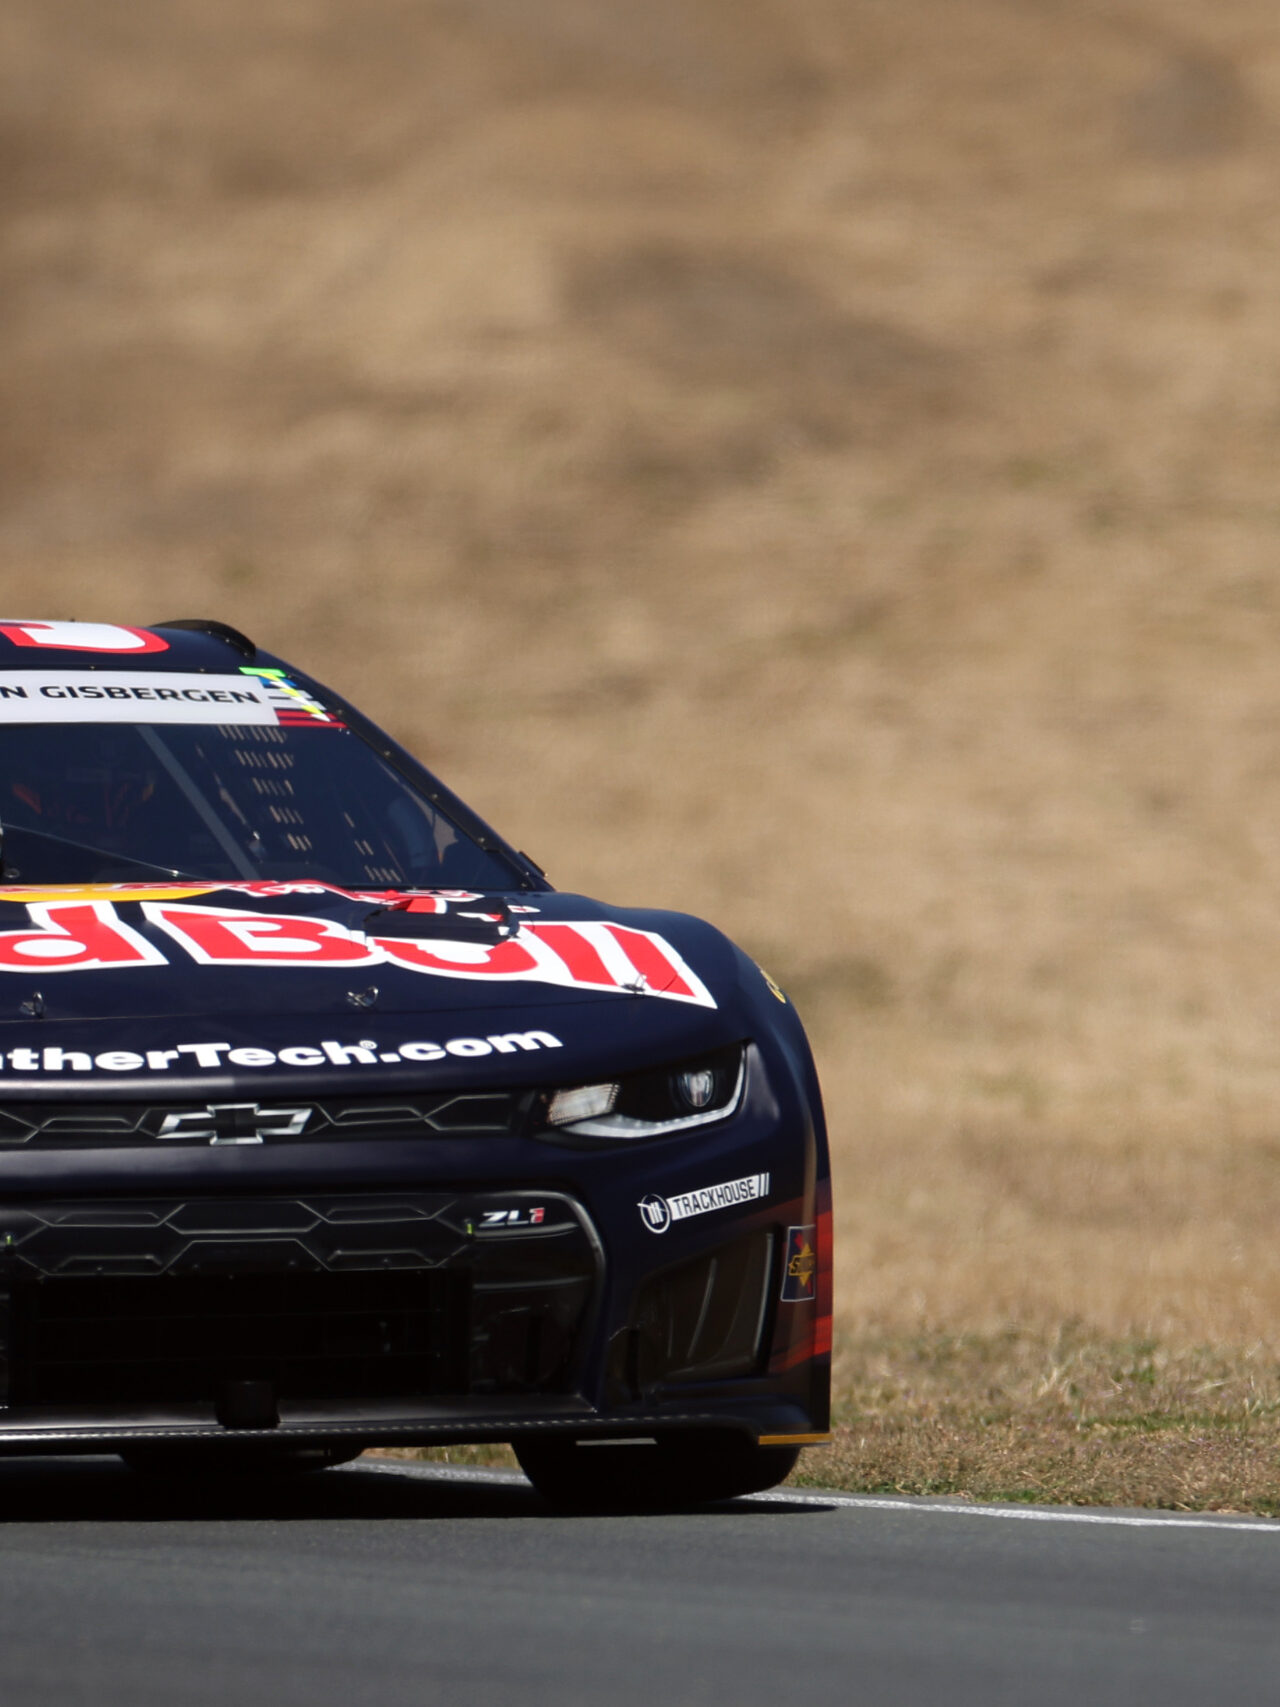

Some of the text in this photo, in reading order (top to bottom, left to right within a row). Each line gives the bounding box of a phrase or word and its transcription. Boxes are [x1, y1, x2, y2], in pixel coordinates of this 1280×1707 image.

[39, 685, 263, 704] GISBERGEN
[673, 1178, 757, 1217] TRACKHOUSE
[479, 1206, 546, 1228] ZL1
